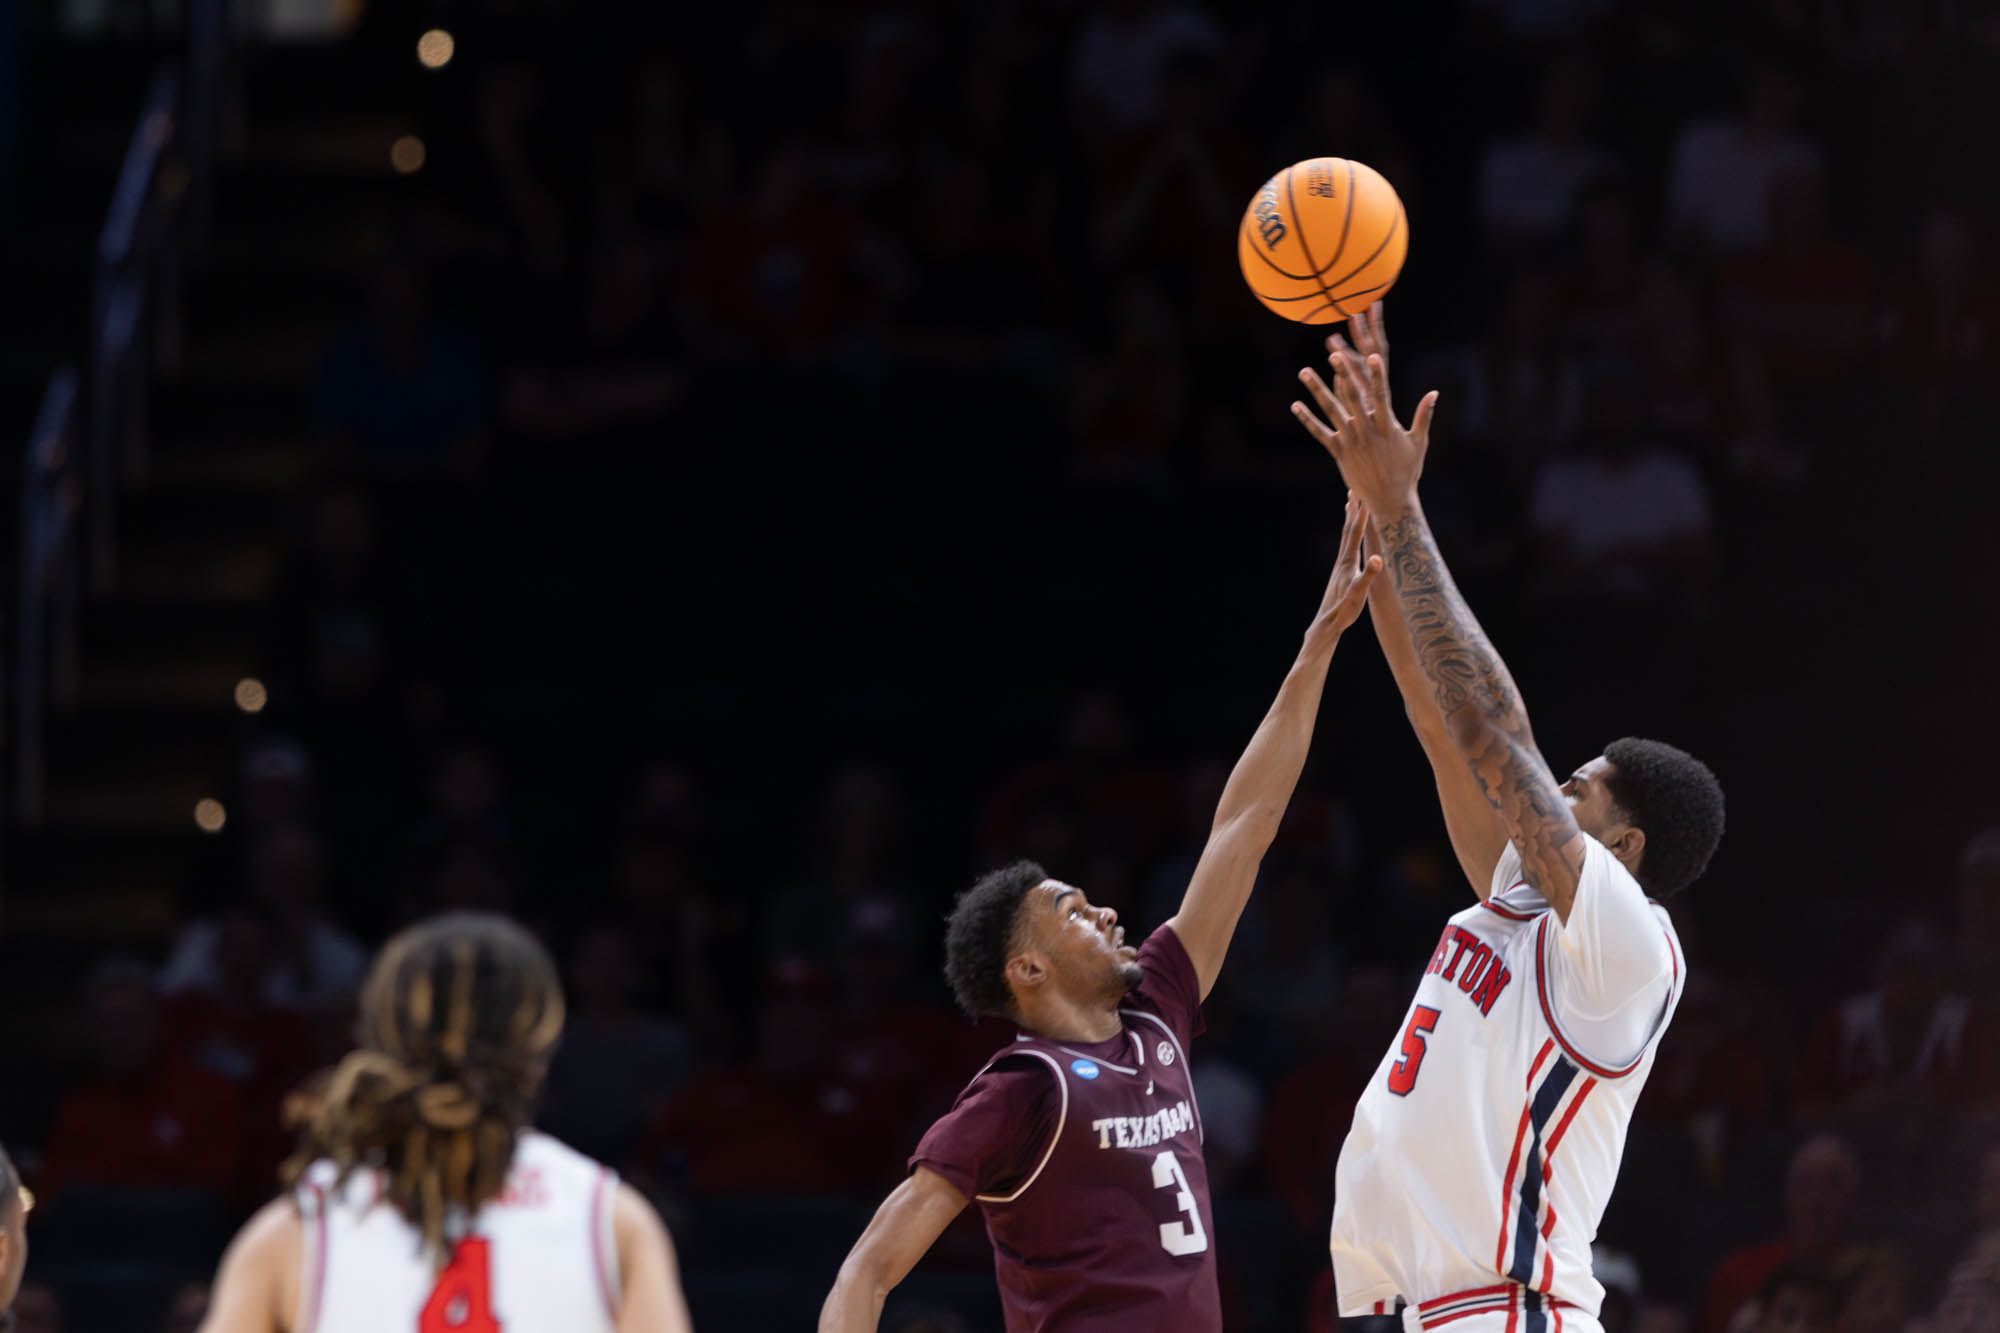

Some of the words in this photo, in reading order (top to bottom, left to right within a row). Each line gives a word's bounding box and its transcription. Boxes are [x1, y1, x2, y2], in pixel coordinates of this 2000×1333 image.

[1427, 924, 1511, 1018] STON
[1388, 1004, 1442, 1097] 5
[1092, 1114, 1160, 1149] TEXAS
[1152, 1151, 1207, 1256] 3
[418, 1236, 503, 1333] 4
